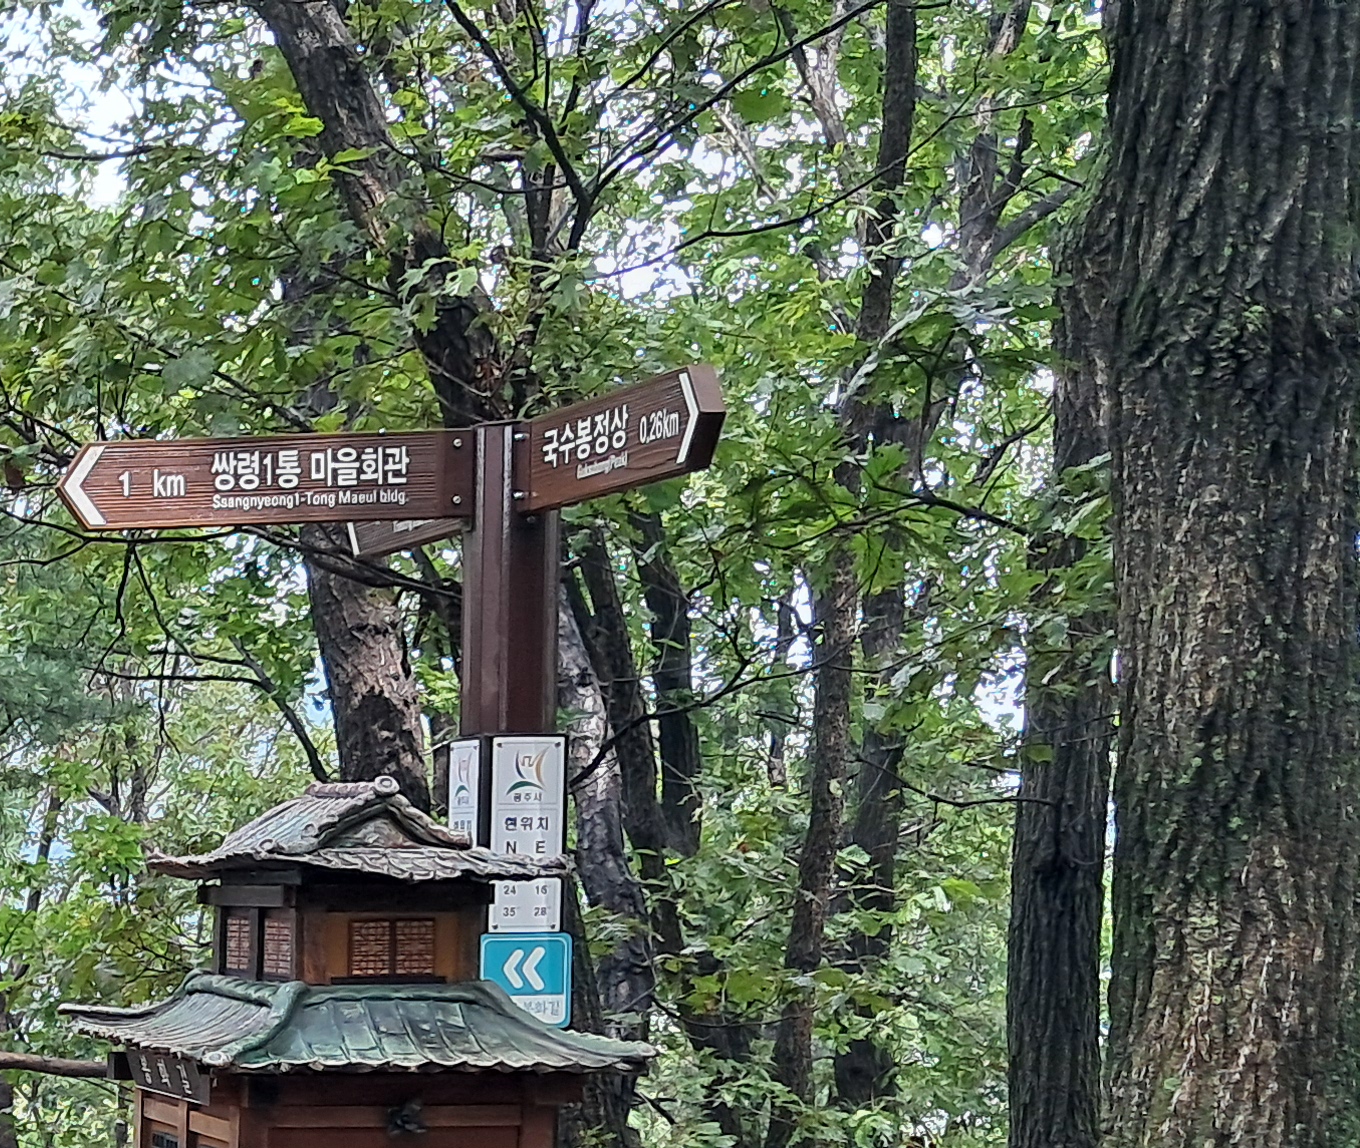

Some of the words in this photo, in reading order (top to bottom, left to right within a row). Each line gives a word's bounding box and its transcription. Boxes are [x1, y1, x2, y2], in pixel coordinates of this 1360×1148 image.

[541, 404, 628, 468] 국수봉정상
[639, 408, 679, 444] 0.26km
[118, 471, 132, 497] 1
[153, 469, 186, 497] km
[211, 449, 302, 491] 쌍령1통
[310, 446, 410, 487] 마을회관
[338, 489, 377, 505] Maeul
[504, 816, 549, 831] 현위치
[506, 840, 517, 854] N
[535, 840, 546, 854] E
